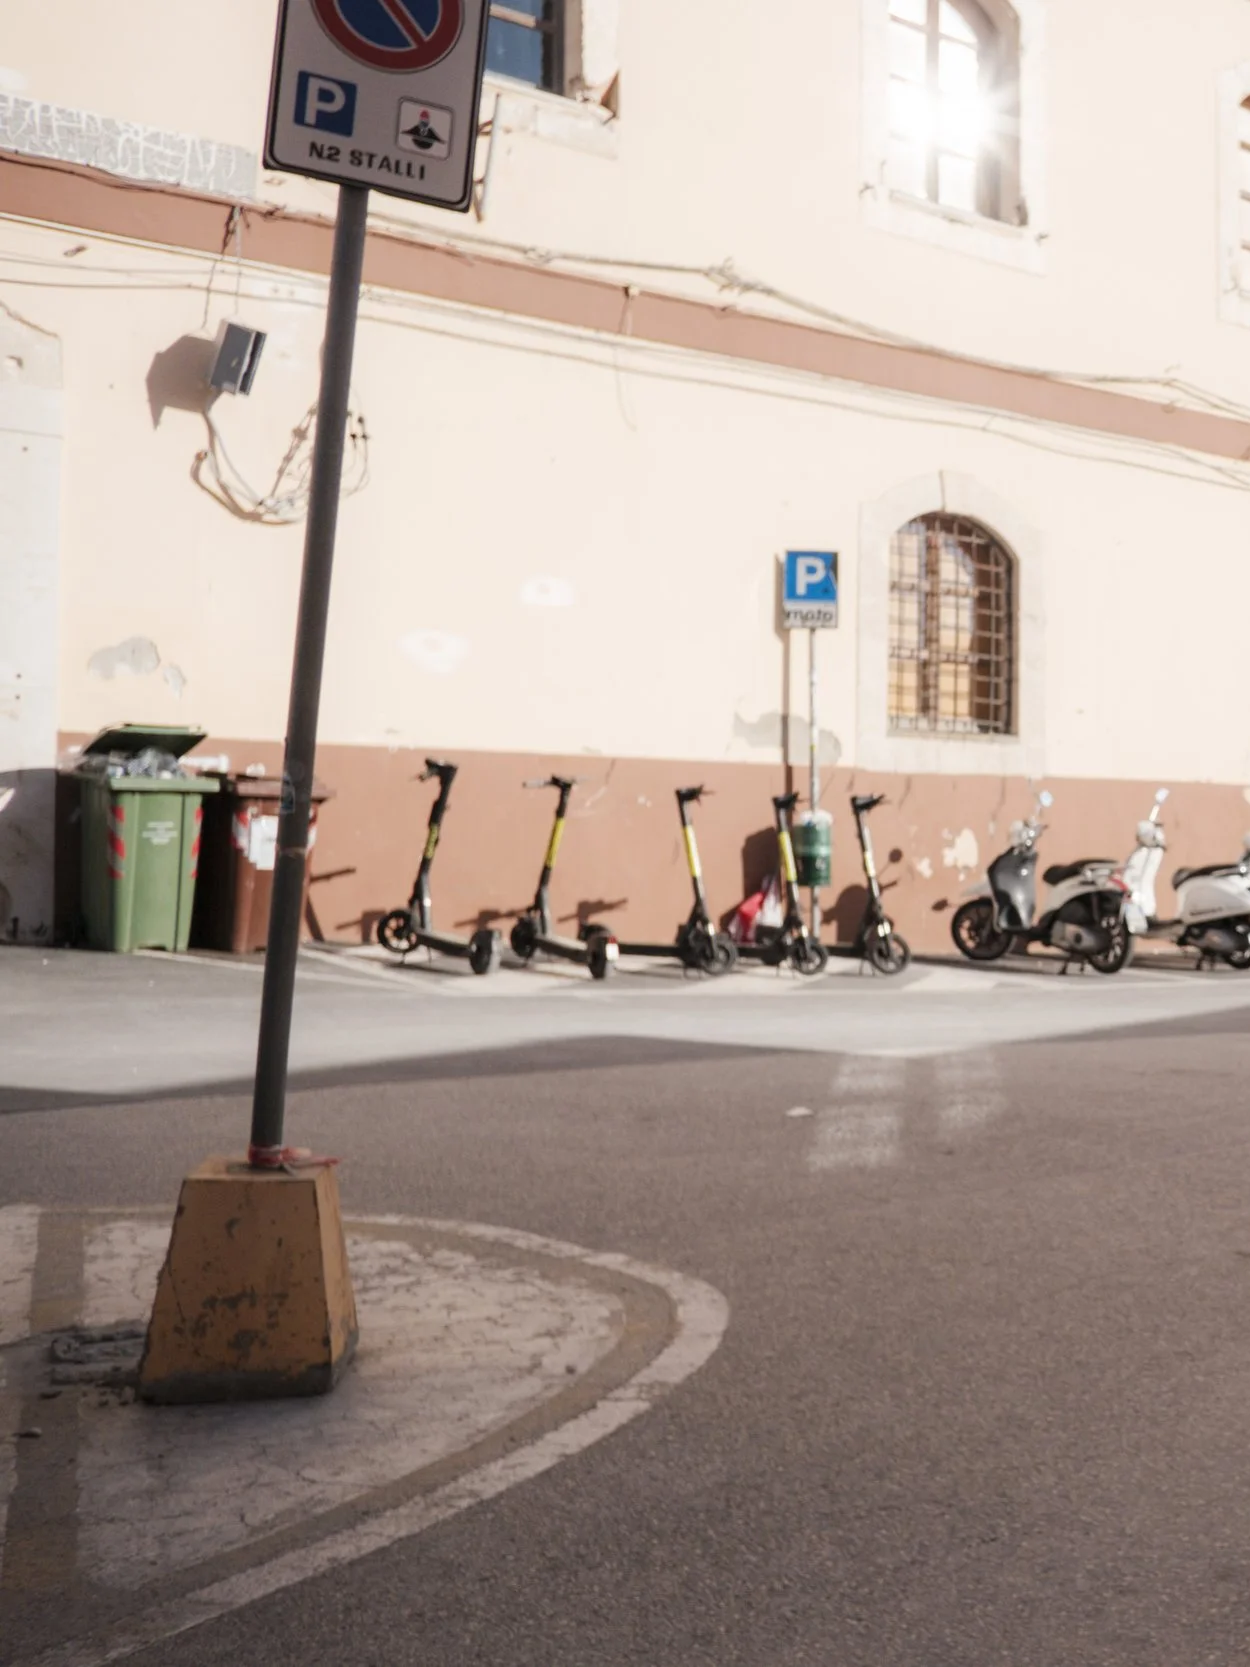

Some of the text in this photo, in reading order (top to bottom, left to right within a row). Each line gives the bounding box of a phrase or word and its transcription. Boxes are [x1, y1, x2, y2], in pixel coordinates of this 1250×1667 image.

[303, 75, 346, 125] P
[349, 148, 425, 180] STALLI
[796, 556, 826, 596] P
